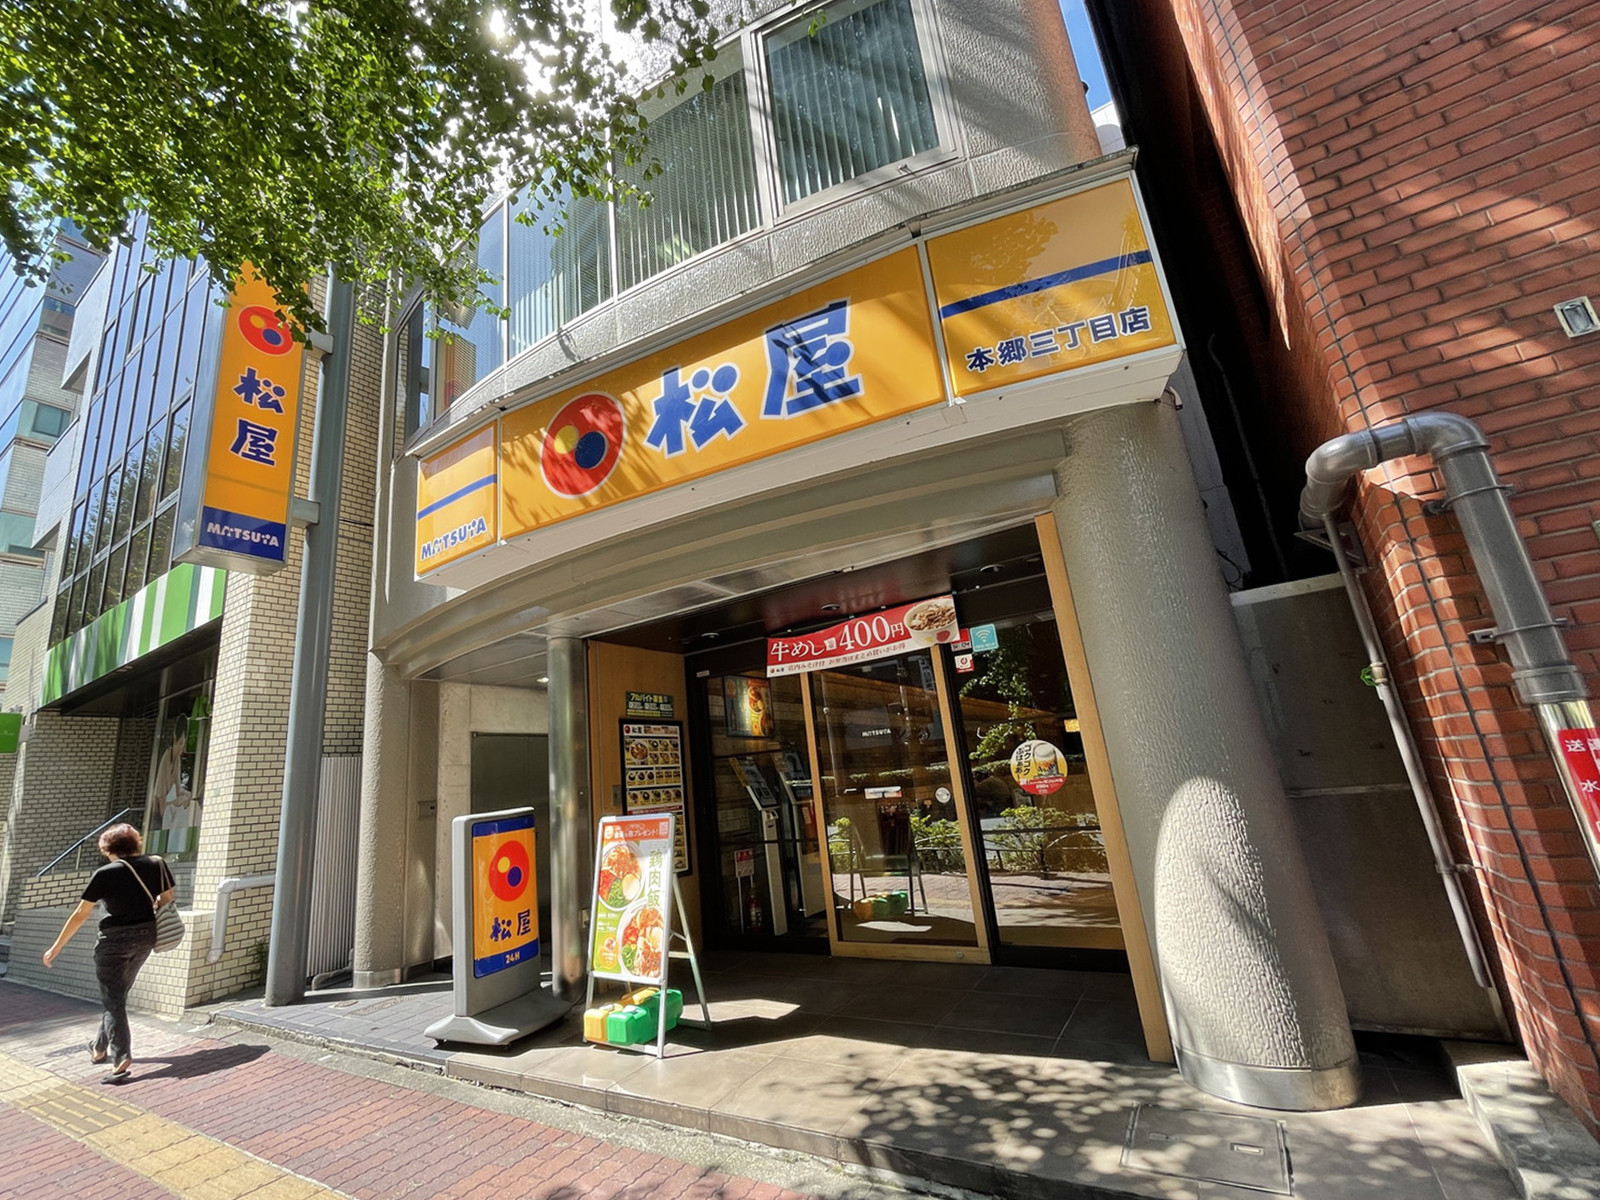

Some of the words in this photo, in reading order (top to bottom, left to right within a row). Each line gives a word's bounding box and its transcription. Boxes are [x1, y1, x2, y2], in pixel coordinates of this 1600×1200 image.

[965, 305, 1152, 373] 本郷三丁目店
[643, 296, 865, 459] 松屋
[230, 366, 286, 468] 松屋
[206, 521, 280, 548] MATSUYA
[419, 516, 487, 561] MATSUYA
[770, 640, 825, 662] 牛めし
[839, 615, 905, 651] 400円
[489, 909, 531, 942] 松屋
[505, 951, 521, 964] 24H
